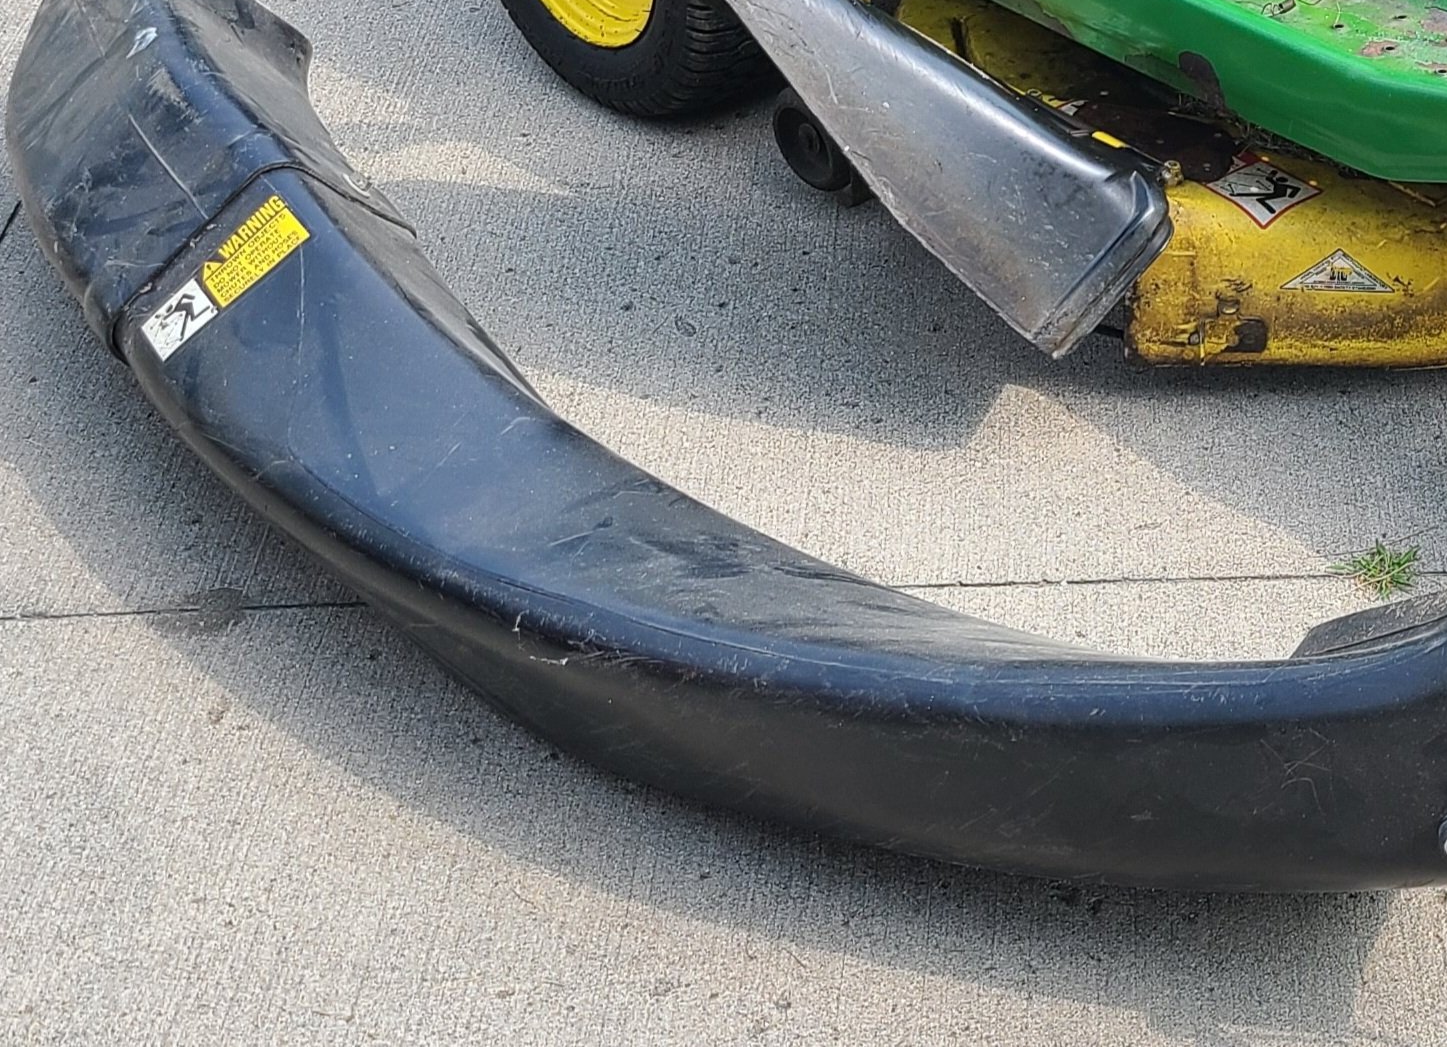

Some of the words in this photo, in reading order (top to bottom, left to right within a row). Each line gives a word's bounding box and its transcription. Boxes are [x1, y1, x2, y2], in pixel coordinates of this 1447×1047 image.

[219, 195, 286, 259] WARNING
[210, 249, 246, 283] THROWN
[213, 277, 226, 290] DO
[227, 261, 243, 278] NOT
